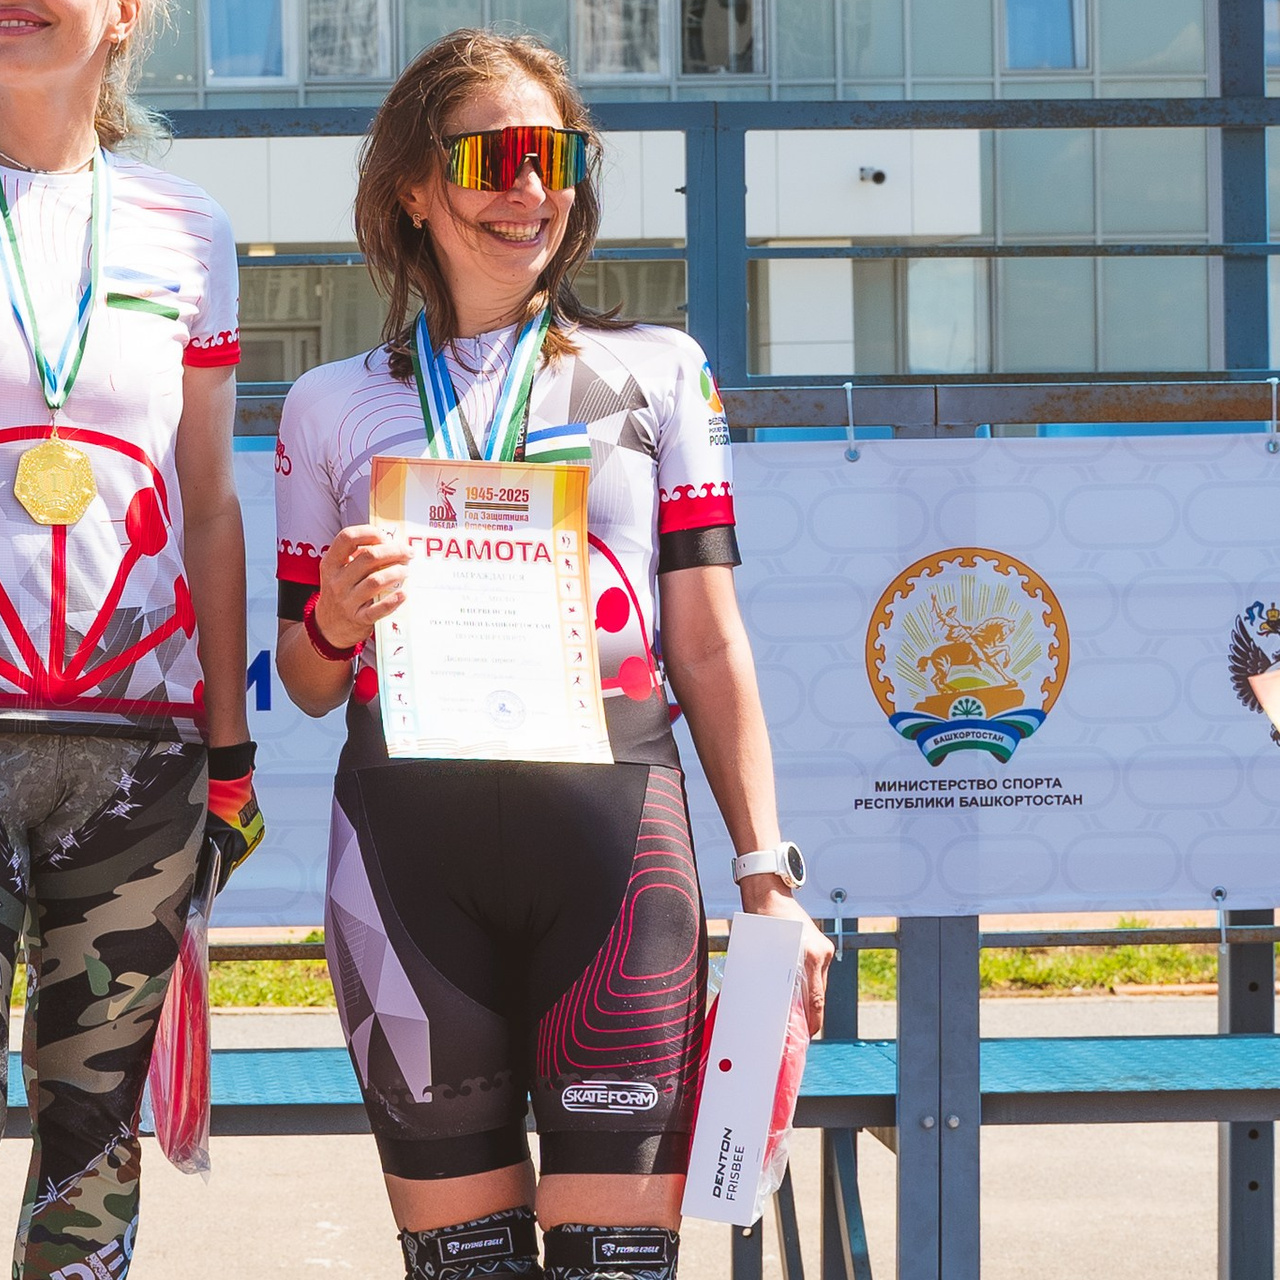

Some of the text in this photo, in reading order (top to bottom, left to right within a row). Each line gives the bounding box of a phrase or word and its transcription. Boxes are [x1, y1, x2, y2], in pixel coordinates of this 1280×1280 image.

[465, 486, 529, 503] 1945-2025
[429, 506, 444, 519] 80
[464, 511, 529, 522] Год Защитника
[408, 535, 553, 564] ГРАМОТА
[874, 777, 1063, 793] МИНИСТЕРСТВО СПОРТА
[854, 794, 1083, 810] РЕСПУБЛИКИ БАШКОРТОСТАН
[565, 1089, 654, 1106] SKATEFORM
[713, 1127, 733, 1199] DENTON
[726, 1145, 745, 1201] FRISBEE
